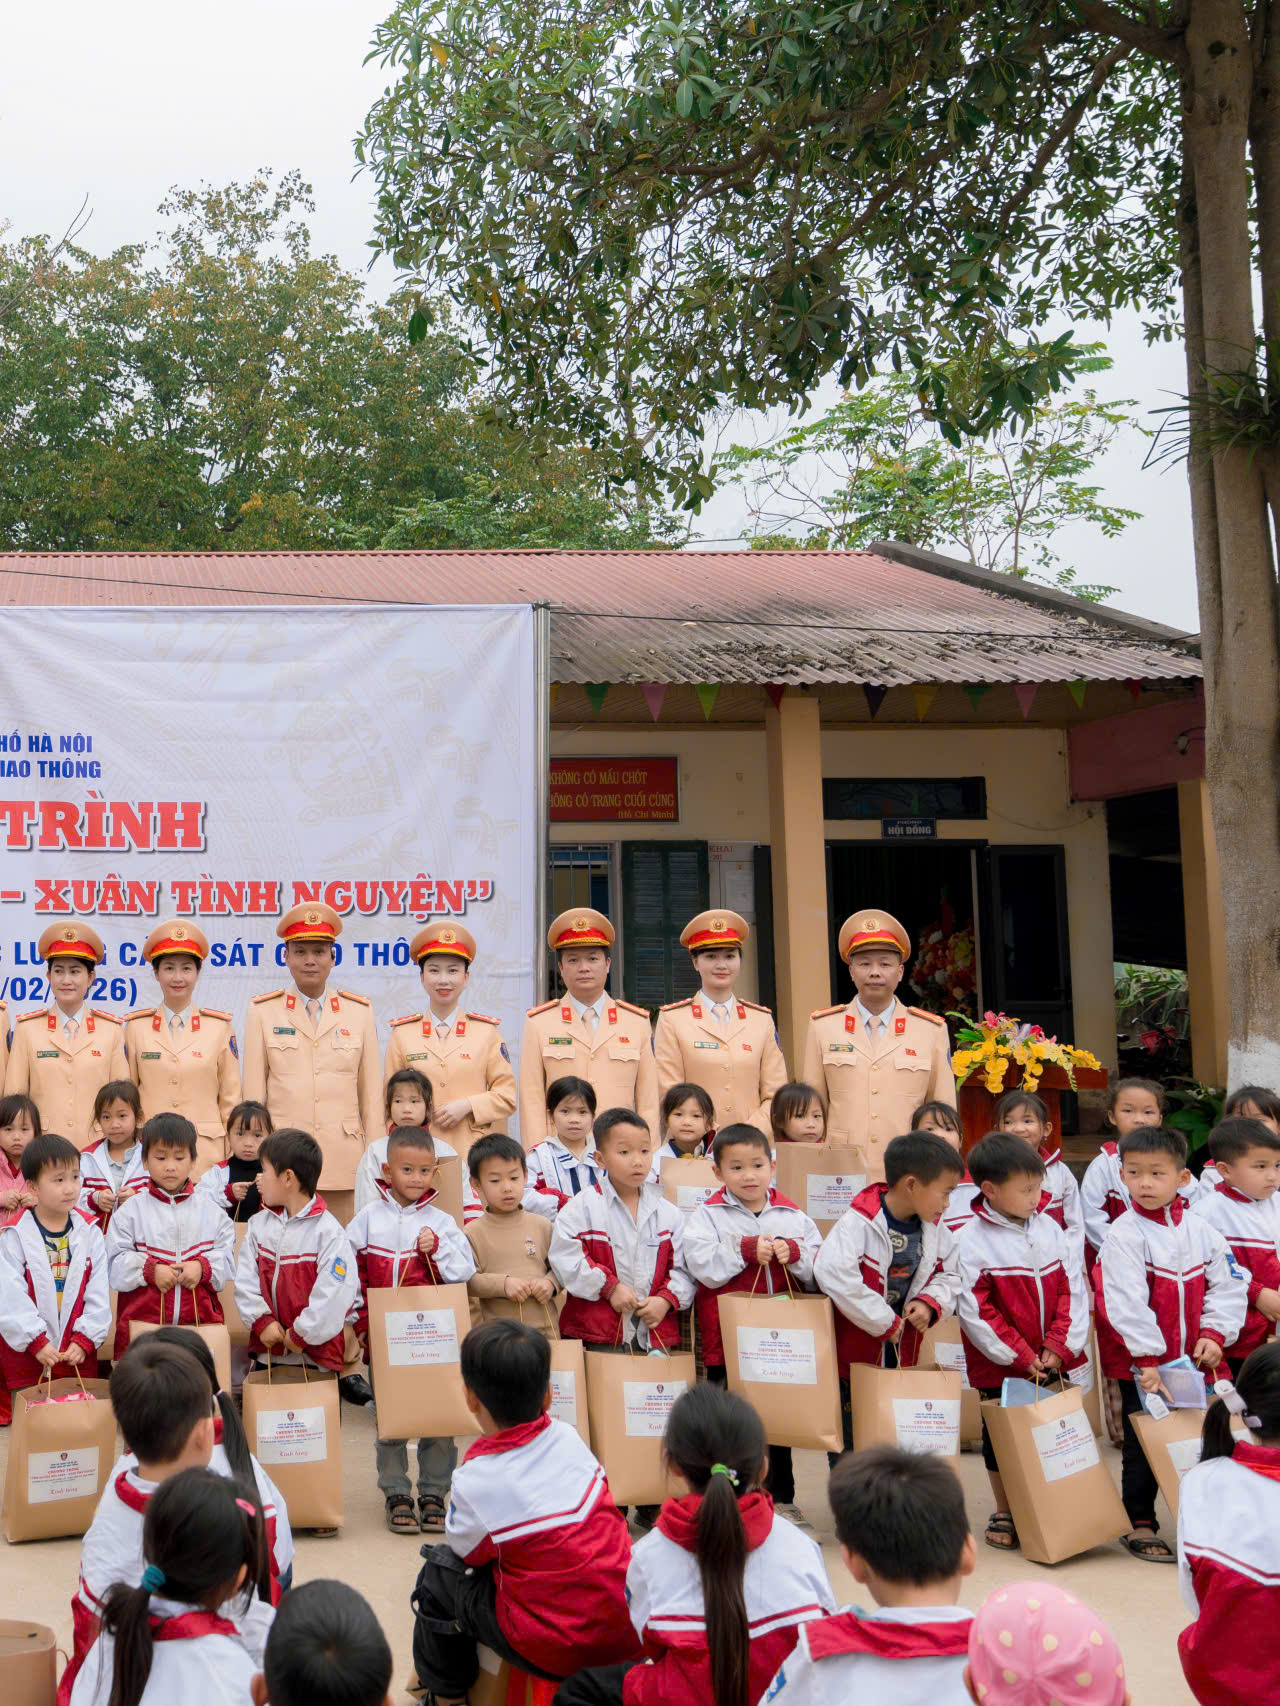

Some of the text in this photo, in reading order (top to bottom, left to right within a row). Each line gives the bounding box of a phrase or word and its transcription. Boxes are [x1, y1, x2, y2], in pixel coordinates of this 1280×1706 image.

[28, 732, 53, 753] HÀ
[60, 732, 93, 757] NỘI
[37, 758, 102, 779] THÔNG
[590, 794, 622, 808] TRANG
[34, 872, 157, 914] XUÂN
[171, 873, 279, 914] TÌNH
[210, 937, 265, 967] SÁT
[353, 936, 411, 967] THÔ
